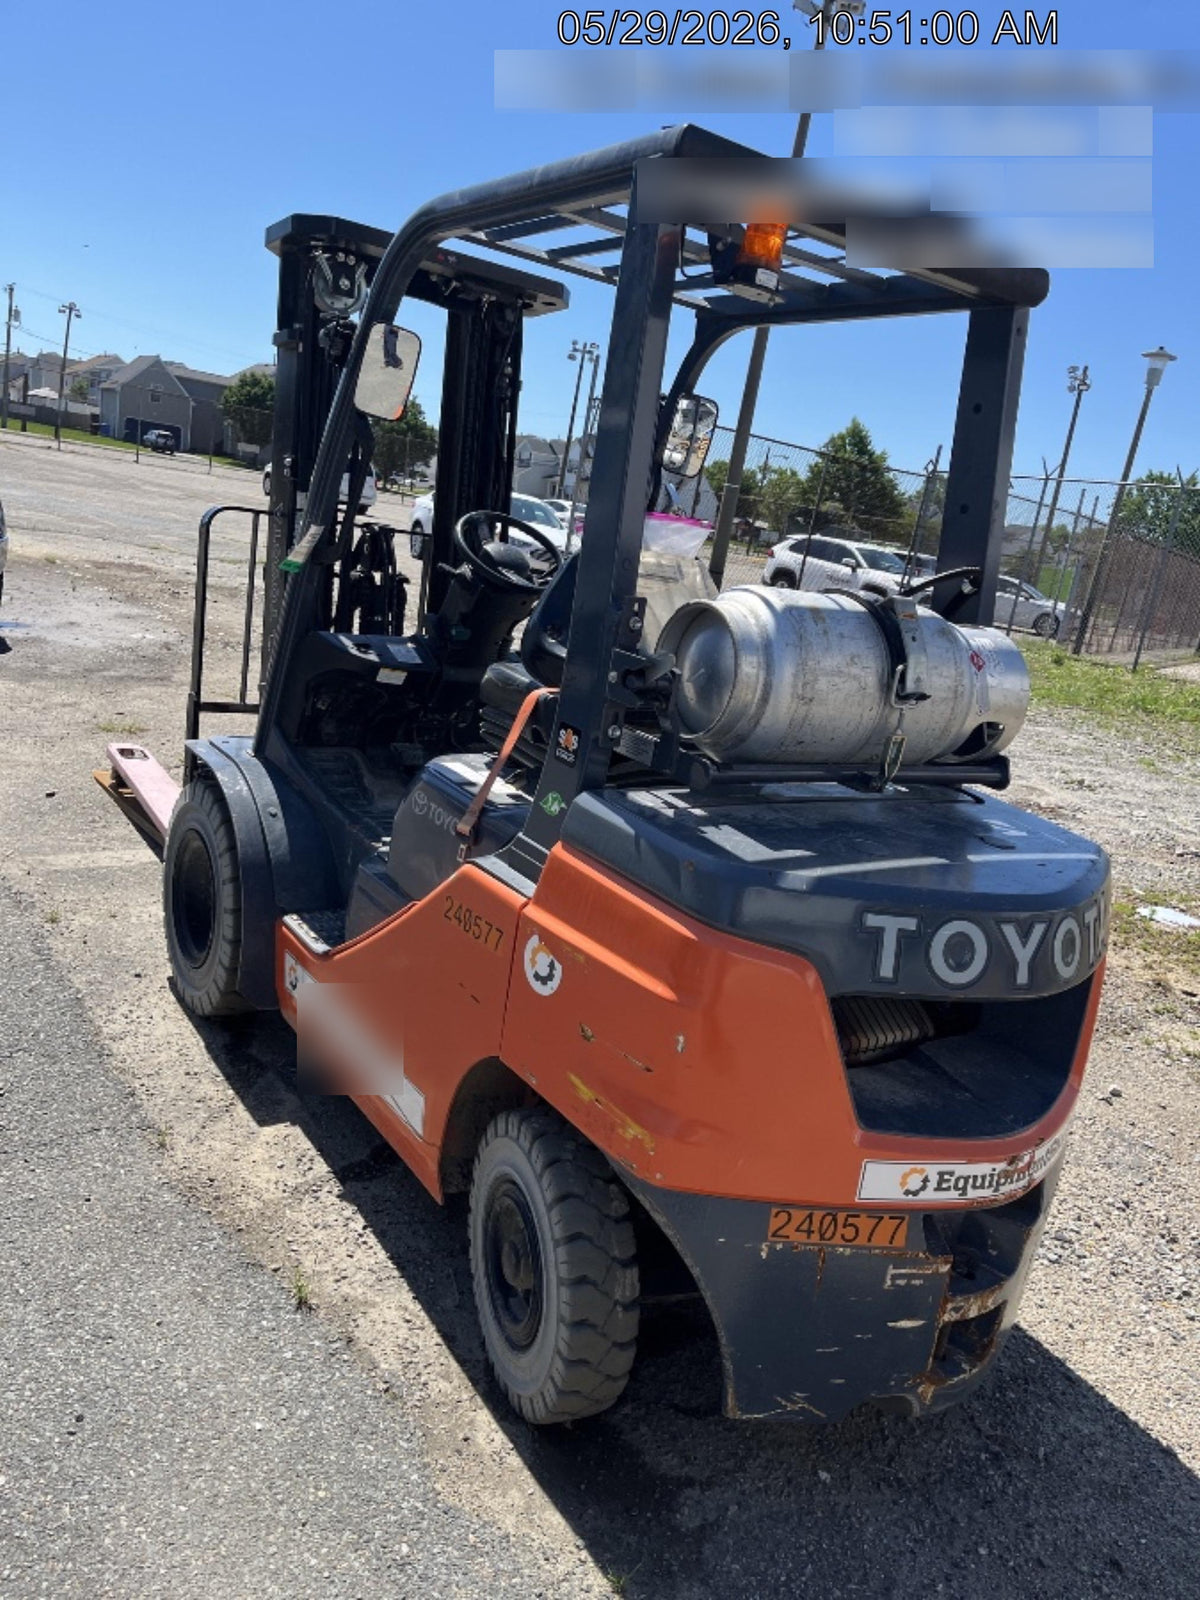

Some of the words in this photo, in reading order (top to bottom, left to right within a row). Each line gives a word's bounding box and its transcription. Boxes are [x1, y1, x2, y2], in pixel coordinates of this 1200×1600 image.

[430, 803, 460, 837] TOYO
[444, 895, 504, 951] 240577
[864, 896, 1105, 985] TOYOT
[770, 1209, 906, 1245] 240577
